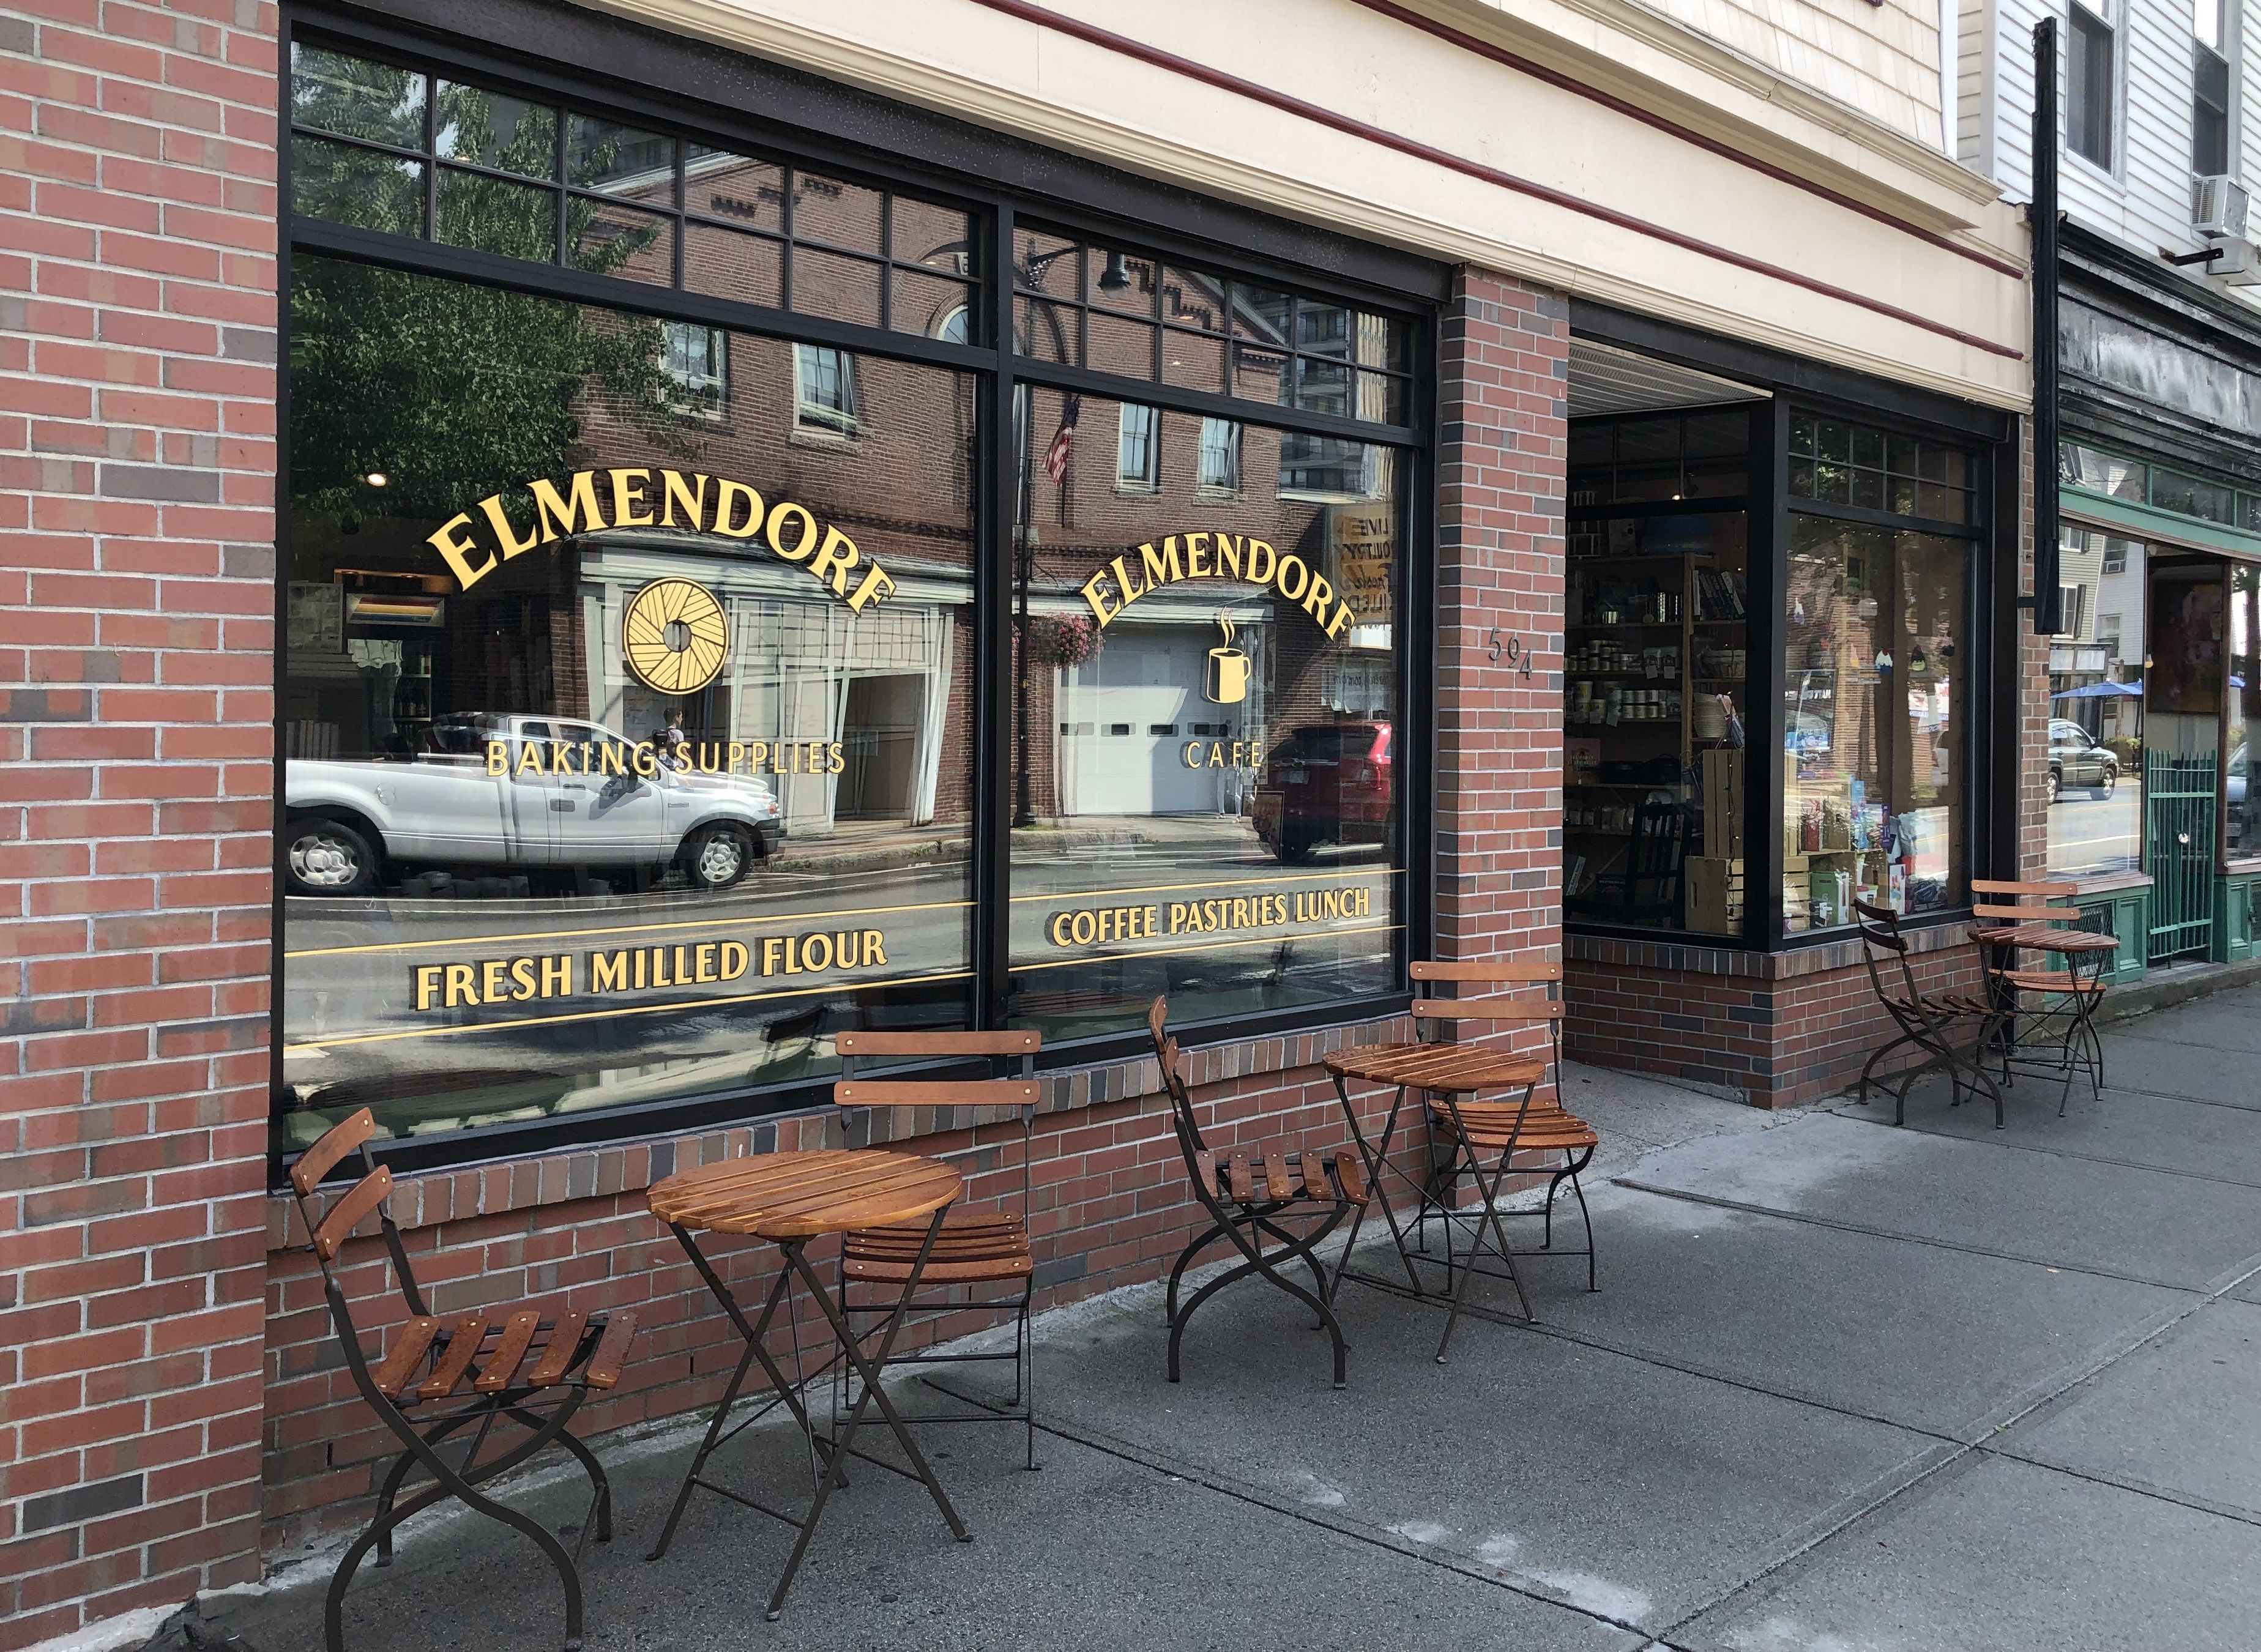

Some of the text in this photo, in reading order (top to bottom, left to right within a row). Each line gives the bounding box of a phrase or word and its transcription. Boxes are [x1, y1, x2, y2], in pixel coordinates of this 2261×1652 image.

[425, 468, 897, 617] ELMENDORF
[1081, 532, 1356, 641] ELMENDORF
[1488, 628, 1532, 680] 594
[486, 740, 846, 777] BAKING SUPPLIES
[1186, 740, 1262, 769] CAFE
[1052, 887, 1370, 947] COFFEE PASTRIES LUNCH
[415, 928, 888, 1012] FRESH MILLED FLOUR
